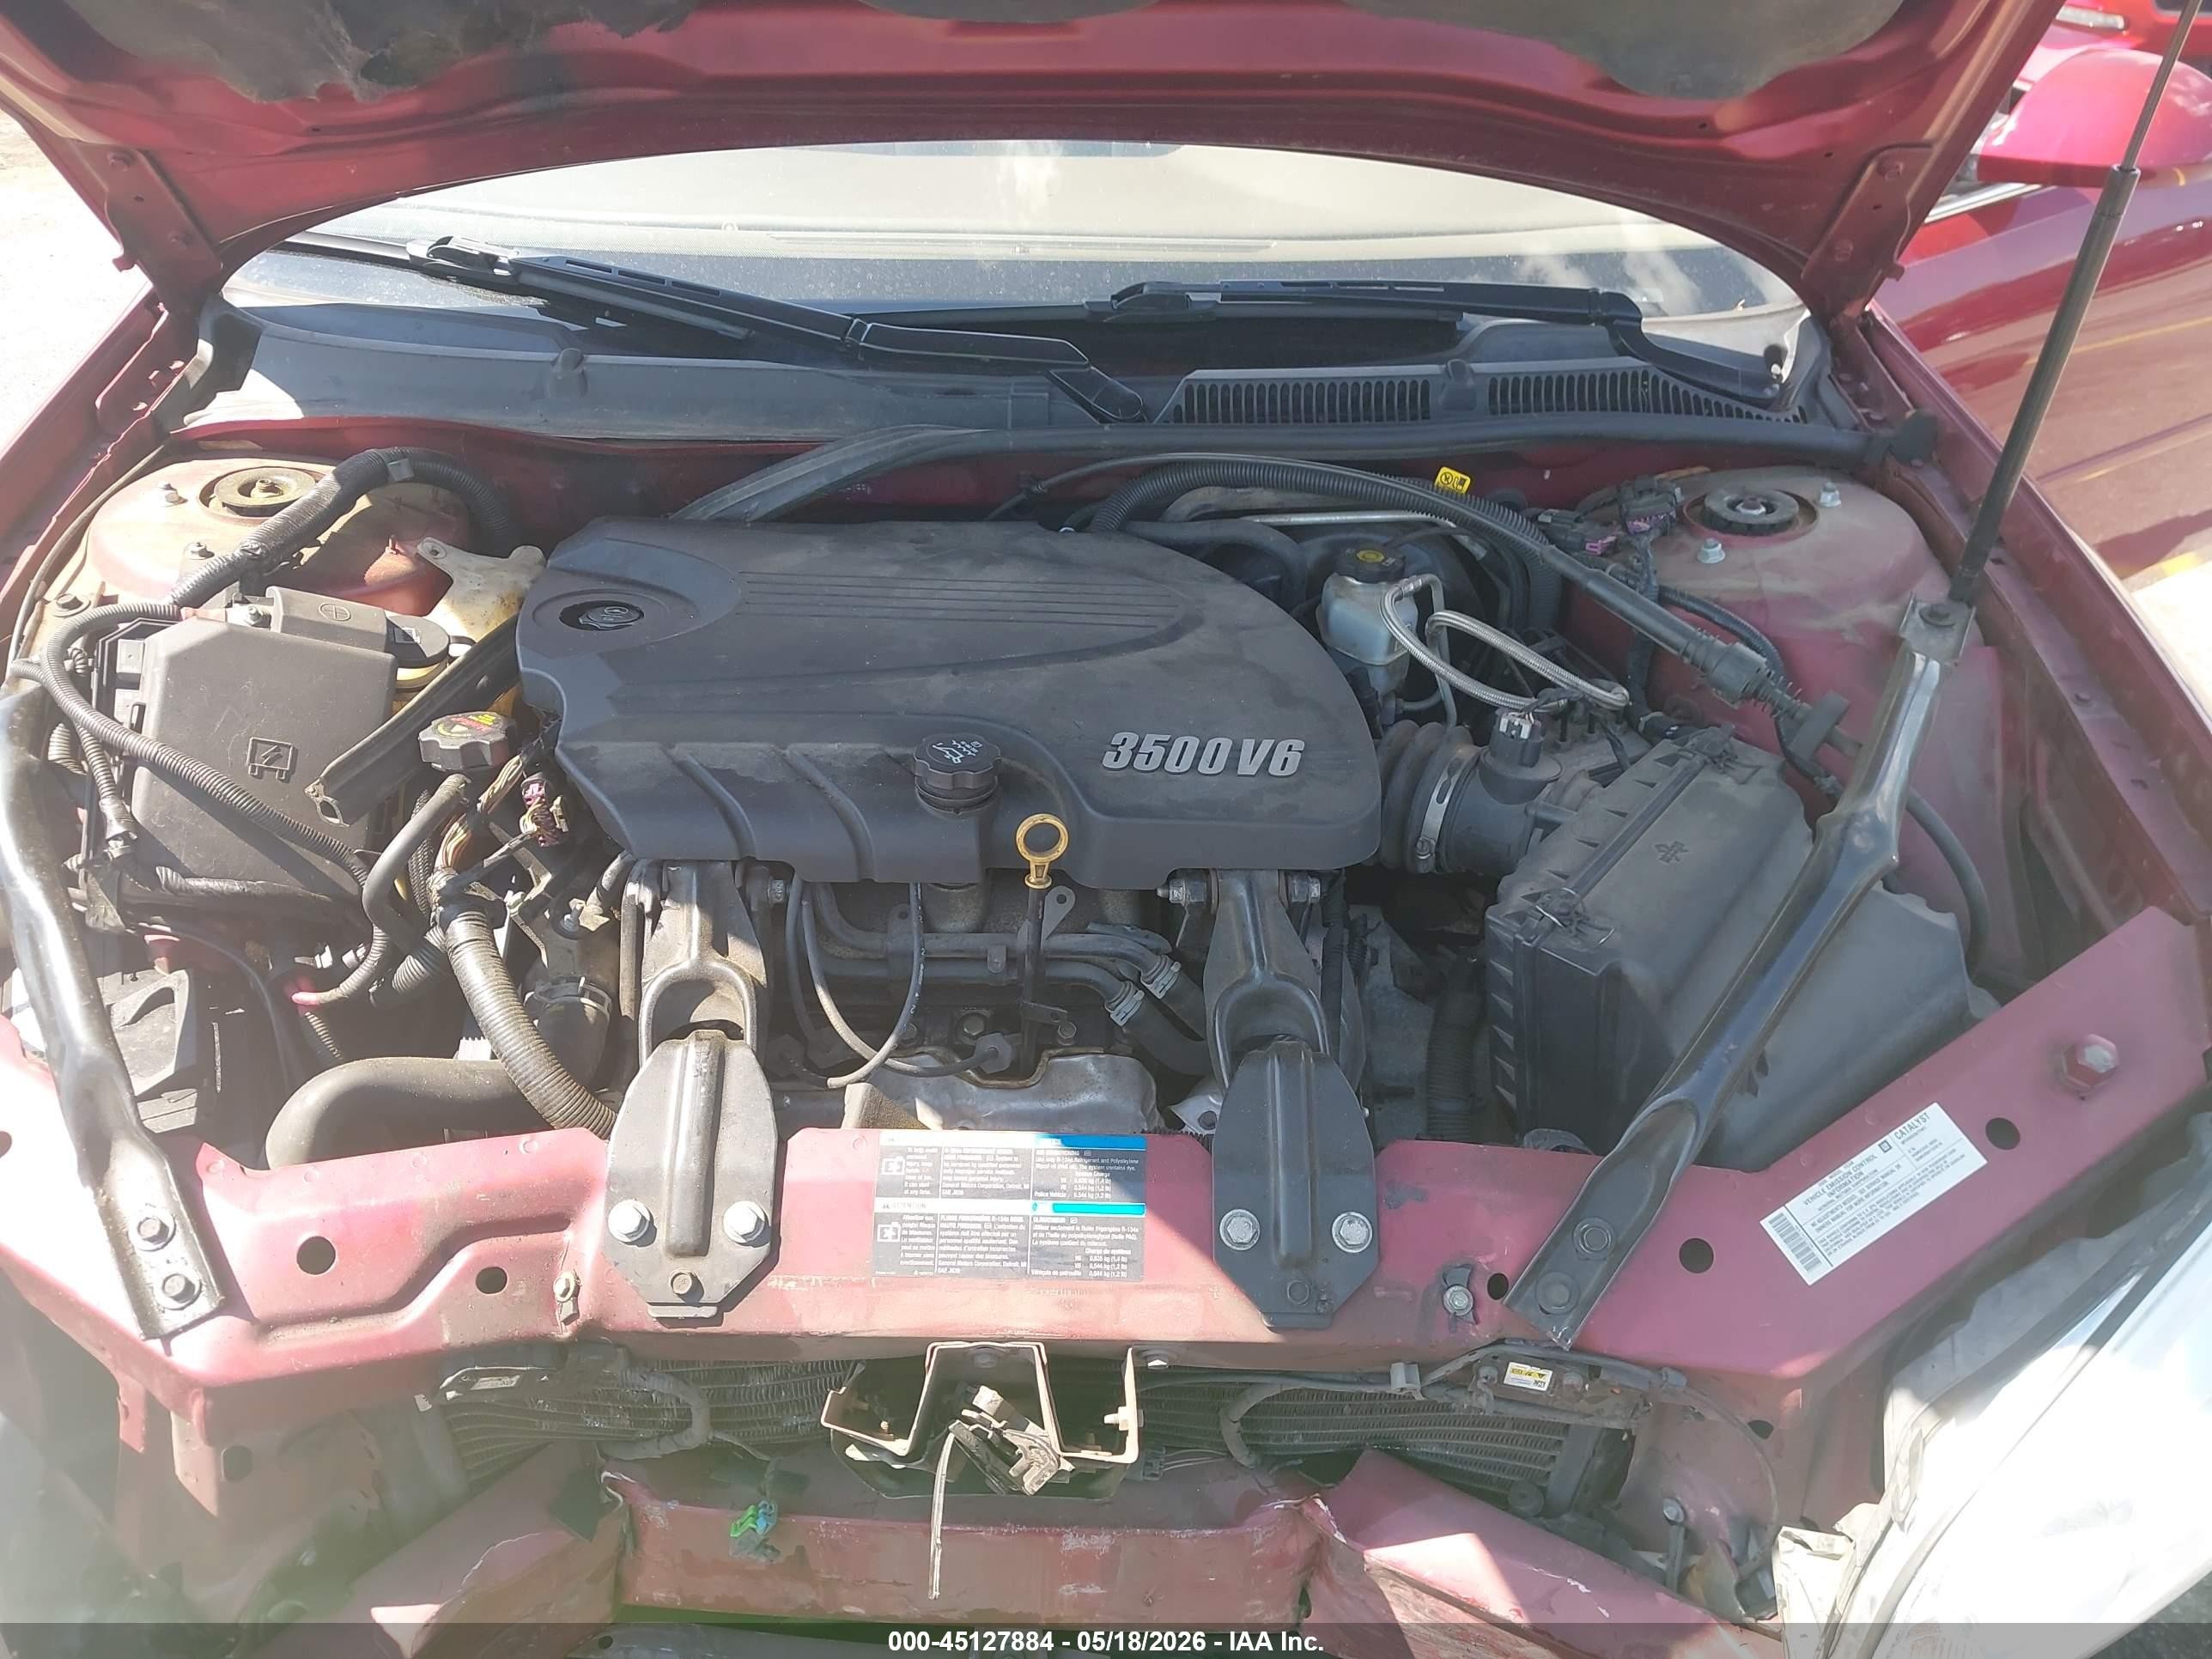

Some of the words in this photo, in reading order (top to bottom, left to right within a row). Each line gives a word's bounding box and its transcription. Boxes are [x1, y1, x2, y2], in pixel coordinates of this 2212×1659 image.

[1102, 732, 1233, 775] 3500
[1237, 738, 1305, 777] V6
[1893, 1111, 1931, 1140] CATALYST
[1802, 1188, 1827, 1206] VEHICLE
[1826, 1170, 1853, 1191] EMISSION
[1851, 1153, 1878, 1173] CONTROL
[1826, 1170, 1864, 1198] INFORMATION
